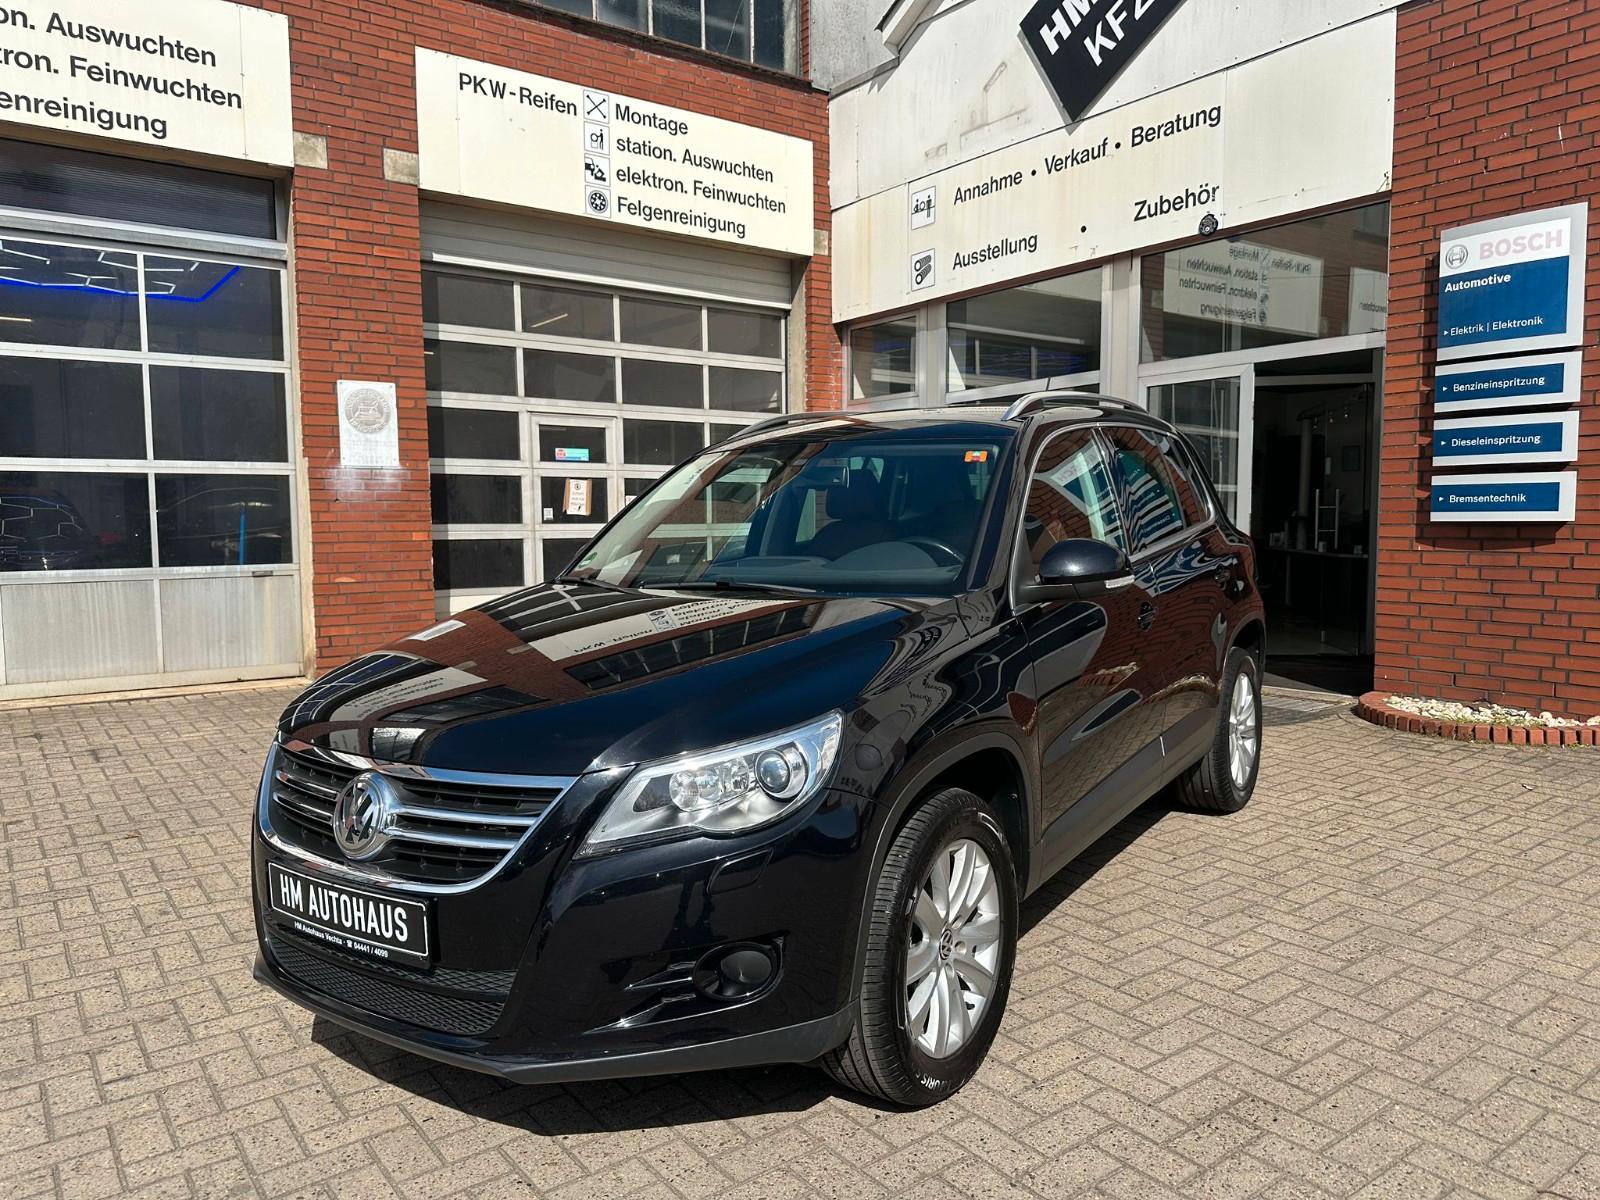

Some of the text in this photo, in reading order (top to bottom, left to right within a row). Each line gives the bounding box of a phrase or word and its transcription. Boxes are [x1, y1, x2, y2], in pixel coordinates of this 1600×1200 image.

[46, 12, 216, 67] Auswuchten
[0, 48, 242, 109] ron. Feinwuchten
[458, 73, 577, 116] PKW-Reifen
[0, 91, 167, 139] enreinigung
[615, 104, 689, 135] Montage
[616, 137, 774, 183] station. Auswuchten
[954, 105, 1221, 205] Annahme Verkauf Beratung
[616, 167, 786, 214] elektron. Feinwuchten
[1133, 183, 1220, 221] Zubehör
[617, 196, 746, 238] Felgenreinigung
[952, 233, 1038, 270] Ausstellung
[1479, 229, 1563, 260] BOSCH
[1444, 273, 1512, 293] Automotive
[1450, 323, 1484, 336] Elektrik
[1492, 316, 1544, 331] Elektronik
[1453, 376, 1546, 392] Benzineinspritzung
[1451, 434, 1541, 447] Dieseleinspritzung
[1449, 493, 1526, 503] Bremsentechnik
[279, 873, 408, 942] HM AUTOHAUS
[294, 921, 302, 930] HM
[302, 925, 324, 939] Autohaus
